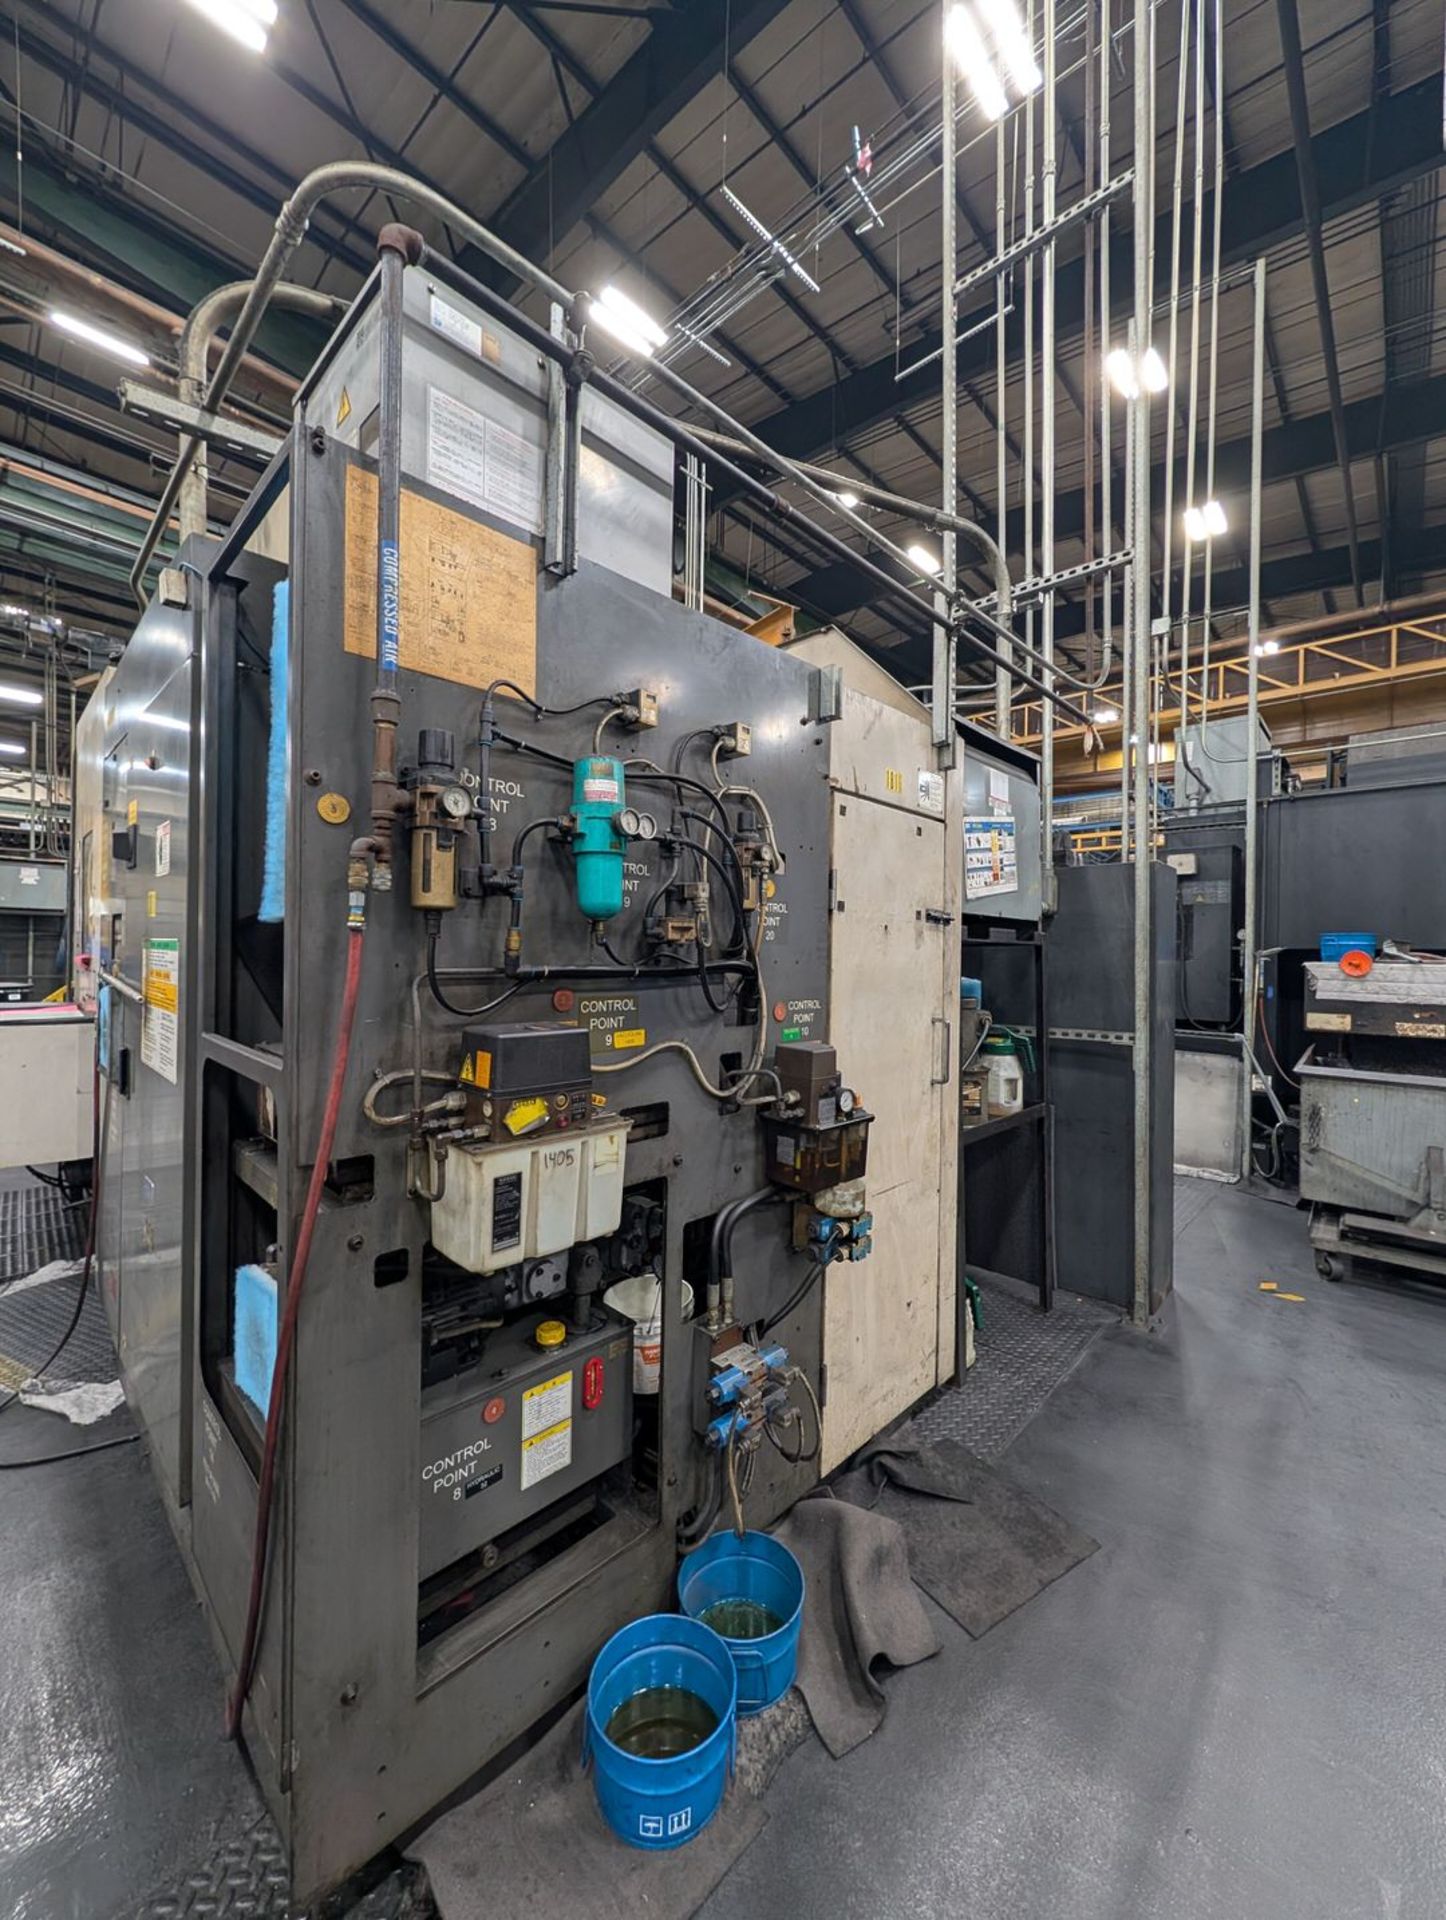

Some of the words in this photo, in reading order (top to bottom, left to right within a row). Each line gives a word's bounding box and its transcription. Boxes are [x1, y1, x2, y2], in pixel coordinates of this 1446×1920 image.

[383, 547, 399, 635] COMPRESSED
[383, 639, 397, 664] AIR
[580, 999, 636, 1014] CONTROL
[787, 999, 822, 1011] CONTROL
[590, 1016, 625, 1030] POINT
[793, 1012, 815, 1024] POINT
[801, 1026, 810, 1036] 10
[605, 1034, 613, 1046] 9
[544, 1148, 575, 1169] 1405
[422, 1437, 493, 1481] CONTROL
[433, 1460, 479, 1494] POINT
[452, 1486, 462, 1501] 8
